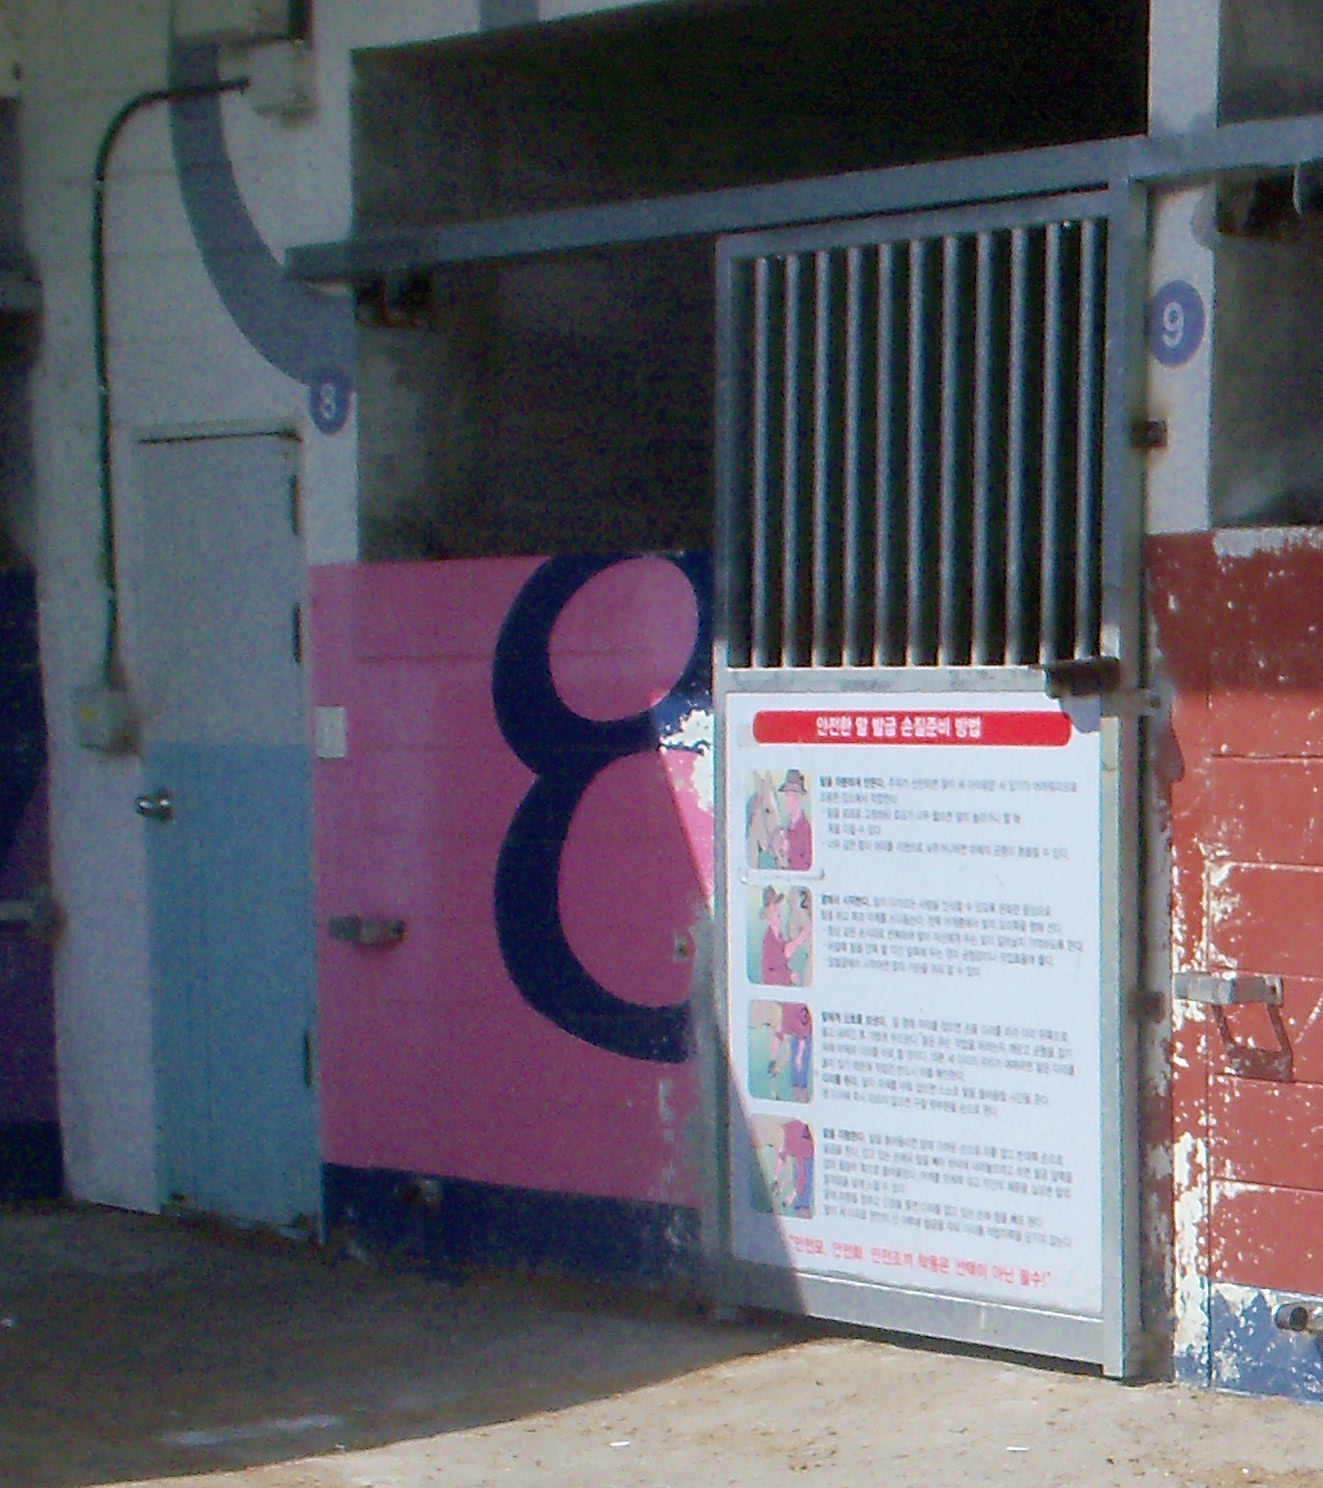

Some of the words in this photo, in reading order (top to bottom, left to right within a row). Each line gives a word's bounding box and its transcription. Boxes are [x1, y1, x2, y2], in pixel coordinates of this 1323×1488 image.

[1163, 302, 1184, 349] 9
[321, 384, 336, 419] 8
[816, 716, 851, 737] 안전한
[901, 716, 950, 738] 손질준비
[955, 717, 982, 738] 방법
